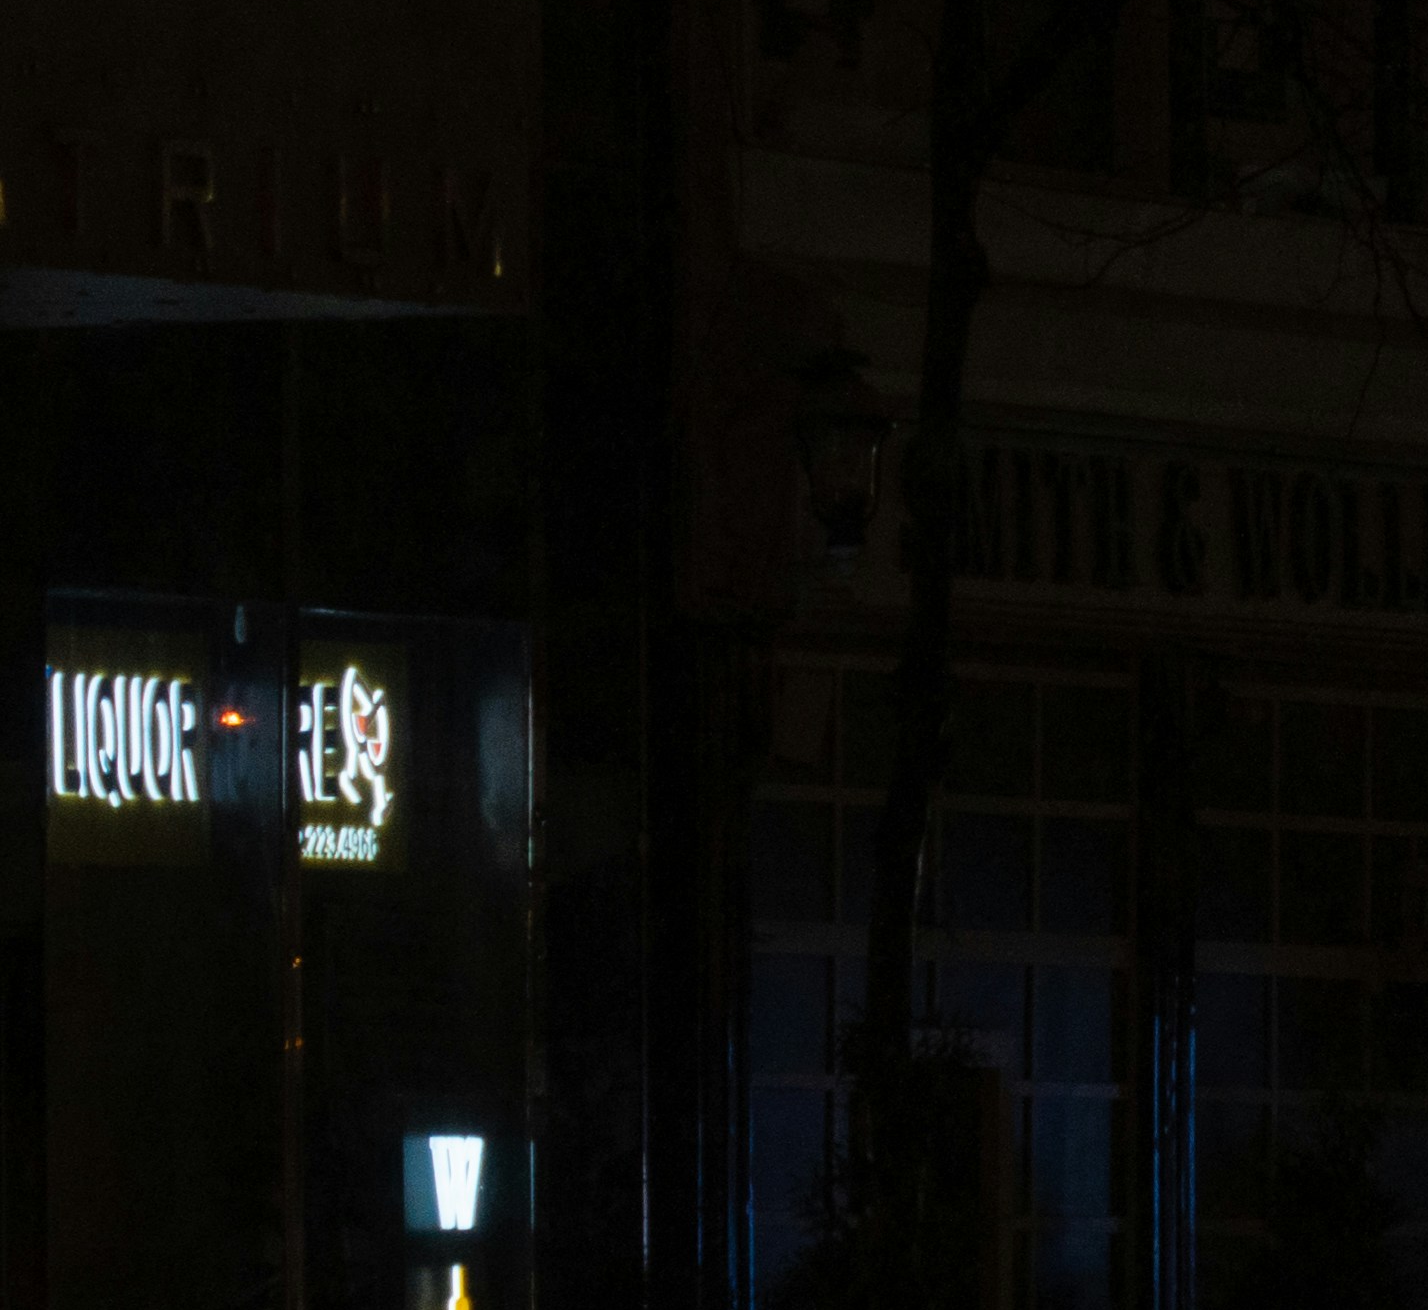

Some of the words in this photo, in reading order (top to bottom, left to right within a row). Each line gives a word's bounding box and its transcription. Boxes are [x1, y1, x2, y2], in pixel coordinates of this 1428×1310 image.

[900, 441, 1134, 589] MITH
[1156, 461, 1206, 596] &
[52, 670, 199, 808] LIQUOR
